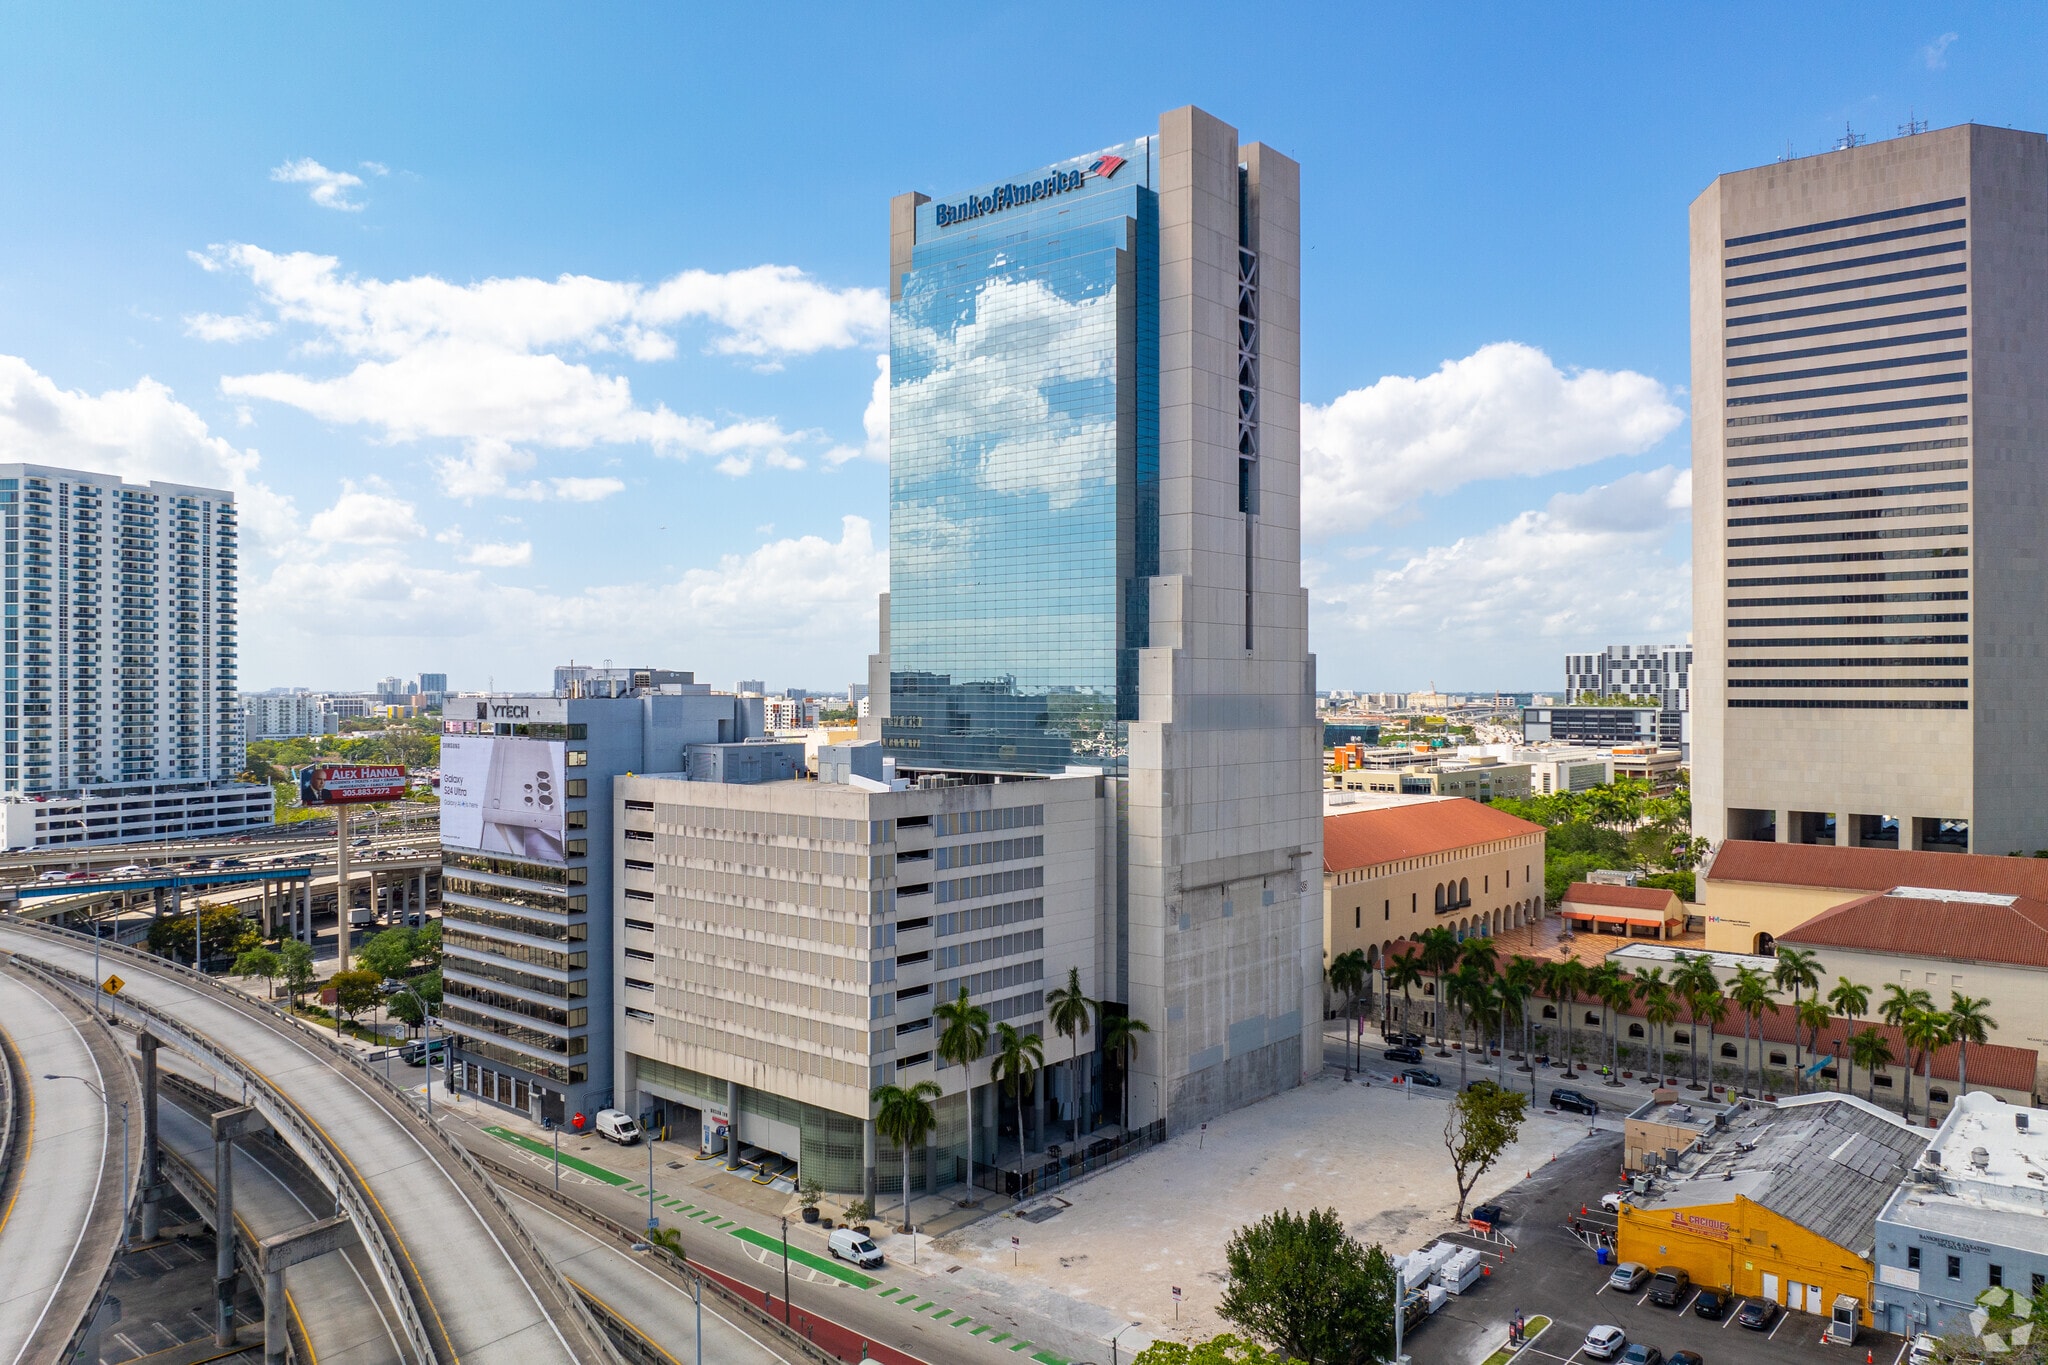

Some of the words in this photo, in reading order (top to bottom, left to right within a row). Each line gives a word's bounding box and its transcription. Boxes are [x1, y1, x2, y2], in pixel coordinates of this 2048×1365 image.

[491, 705, 529, 718] YTECH
[332, 769, 358, 779] ALEX
[361, 768, 399, 778] HANNA
[444, 774, 463, 786] Galaxy
[342, 788, 390, 797] 305.883.7272
[444, 786, 453, 795] S24
[454, 787, 467, 796] Ultra
